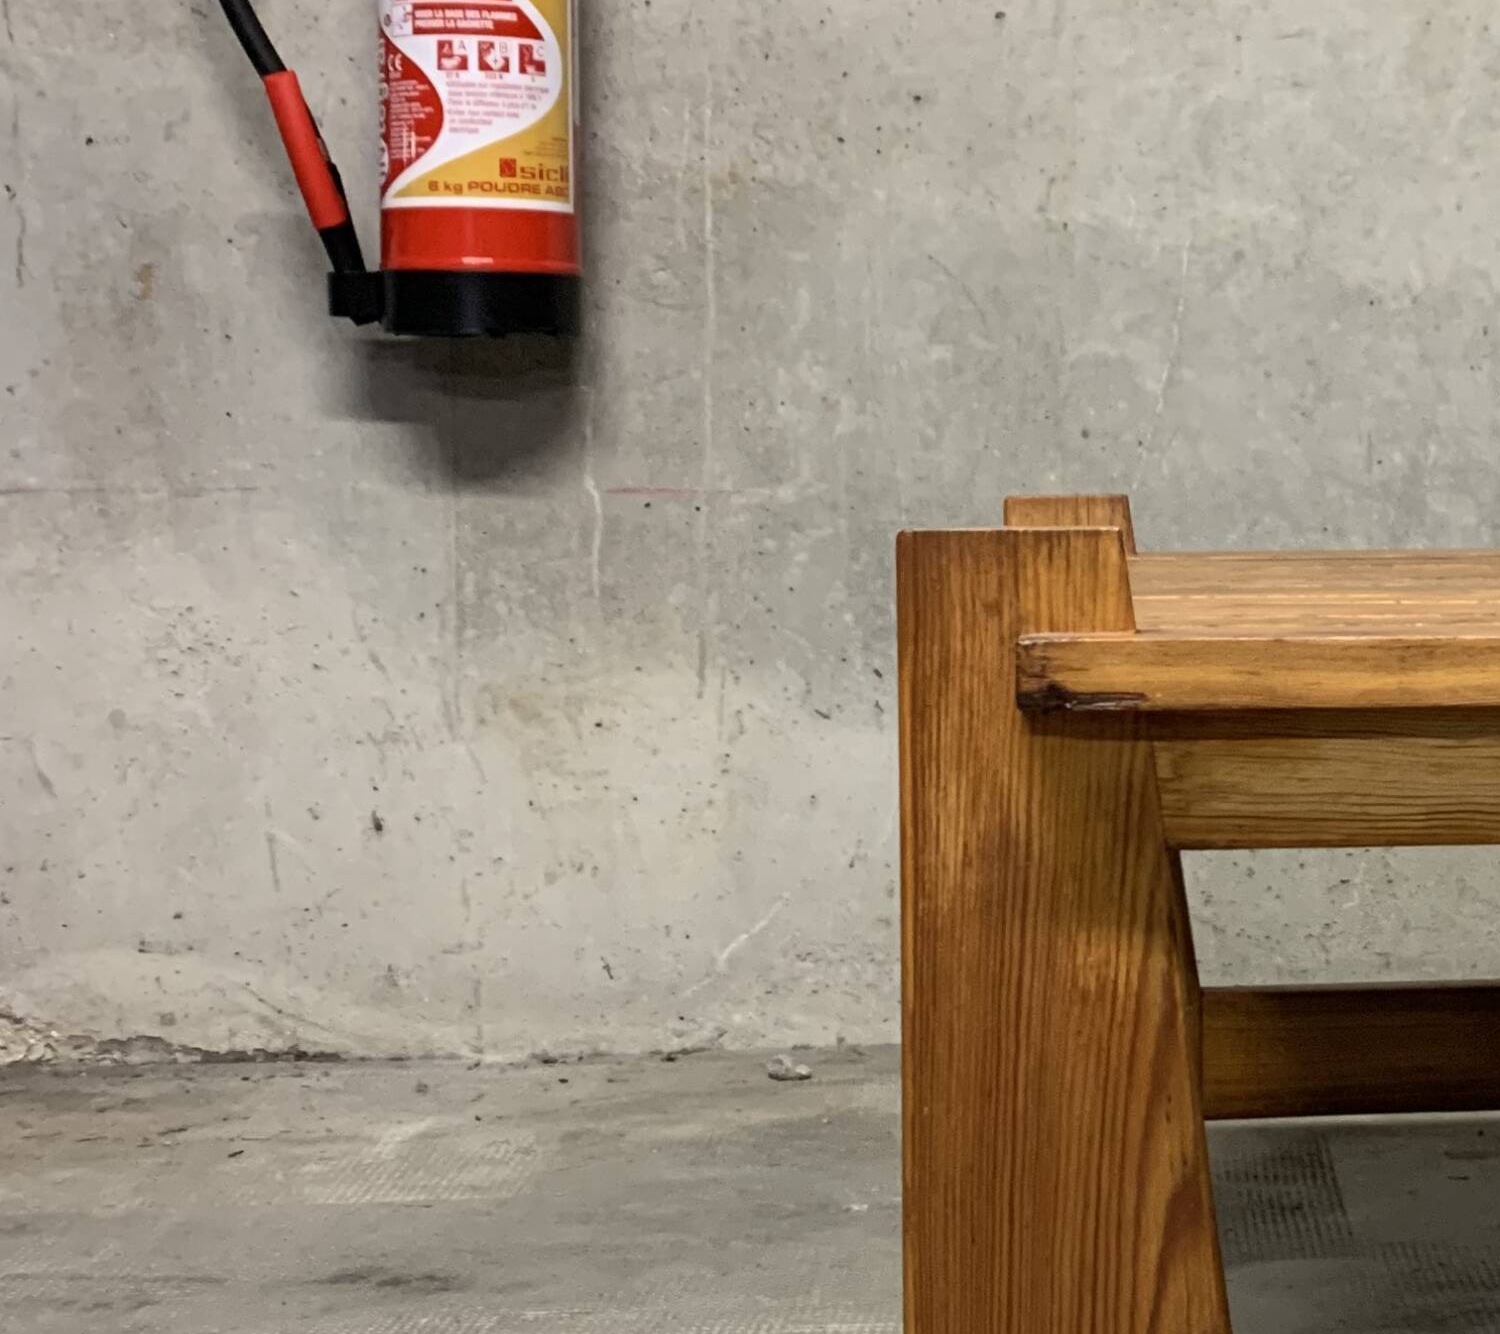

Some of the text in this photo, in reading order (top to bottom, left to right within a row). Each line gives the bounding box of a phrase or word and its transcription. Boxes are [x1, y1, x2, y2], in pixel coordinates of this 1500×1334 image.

[458, 40, 467, 51] A
[536, 45, 545, 58] C
[443, 180, 464, 195] kg
[467, 180, 542, 195] POUDRE
